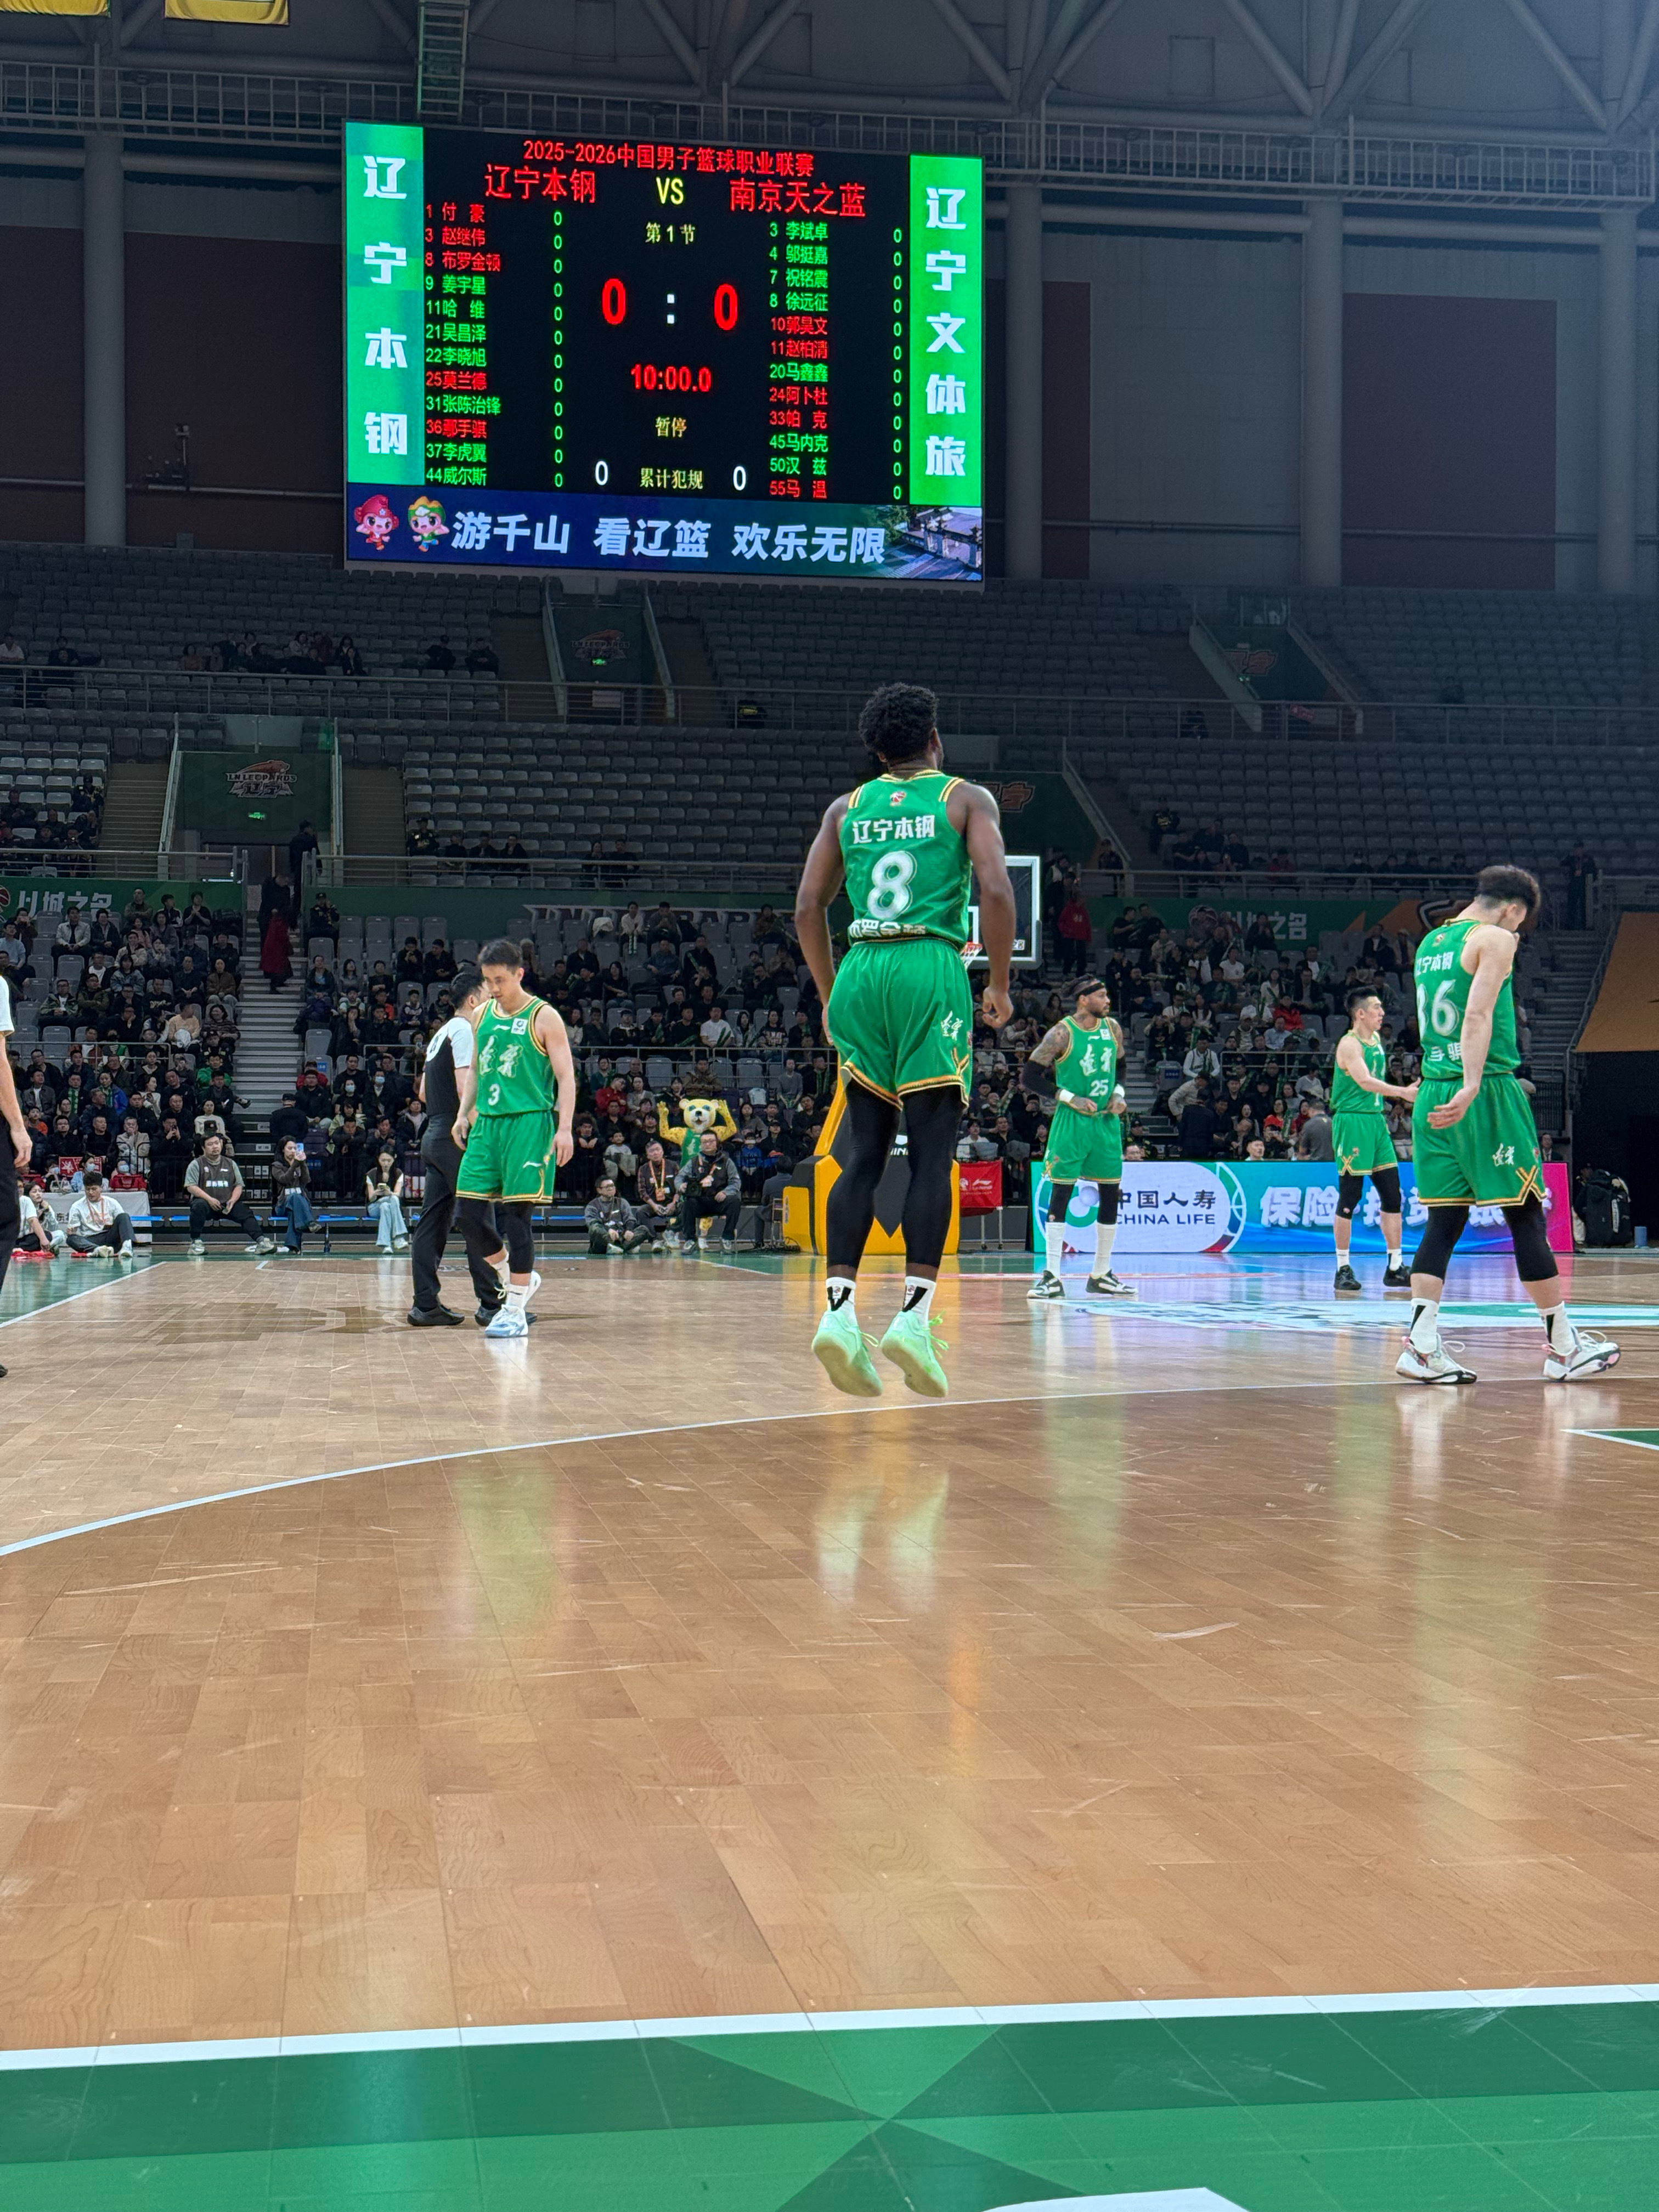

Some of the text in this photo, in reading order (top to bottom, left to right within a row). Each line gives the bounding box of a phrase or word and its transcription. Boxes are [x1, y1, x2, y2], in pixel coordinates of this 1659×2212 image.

[523, 140, 814, 177] 2025-2026中国男子篮球职业联赛
[485, 163, 865, 217] 辽宁本钢 VS 南京天之蓝
[427, 205, 431, 217] 1
[554, 211, 562, 225] 0
[426, 228, 433, 242] 3
[554, 235, 562, 249] 0
[770, 222, 777, 236] 3
[894, 228, 902, 242] 0
[426, 252, 434, 267] 8
[554, 259, 562, 273] 0
[770, 247, 777, 260] 4
[894, 252, 902, 266] 0
[426, 275, 433, 290] 9
[554, 283, 562, 297] 0
[770, 269, 777, 284] 7
[894, 275, 901, 290] 0
[363, 155, 408, 455] 辽宁本钢
[602, 278, 625, 325] 0
[714, 284, 738, 330] 0
[770, 294, 777, 307] 8
[894, 298, 902, 313] 0
[554, 307, 562, 321] 0
[555, 331, 562, 345] 0
[894, 322, 901, 336] 0
[926, 187, 966, 477] 辽宁文体旅
[555, 354, 562, 368] 0
[894, 346, 902, 360] 0
[555, 378, 562, 392] 0
[631, 364, 712, 392] 10:00.0
[894, 369, 902, 383] 0
[555, 402, 562, 416] 0
[894, 392, 901, 407] 0
[555, 426, 562, 439] 0
[656, 417, 687, 438] 暂停
[894, 416, 902, 430] 0
[894, 439, 901, 453] 0
[555, 449, 562, 464] 0
[595, 461, 746, 490] 0 累计犯规 0
[894, 462, 902, 476] 0
[555, 473, 562, 487] 0
[894, 486, 901, 499] 0
[452, 510, 885, 564] 游千山 看辽篮 欢乐无限
[853, 815, 935, 844] 辽宁本钢
[867, 850, 917, 921] 8
[488, 1084, 500, 1106] 3
[1089, 1079, 1109, 1096] 25
[1176, 1214, 1216, 1224] LIFE
